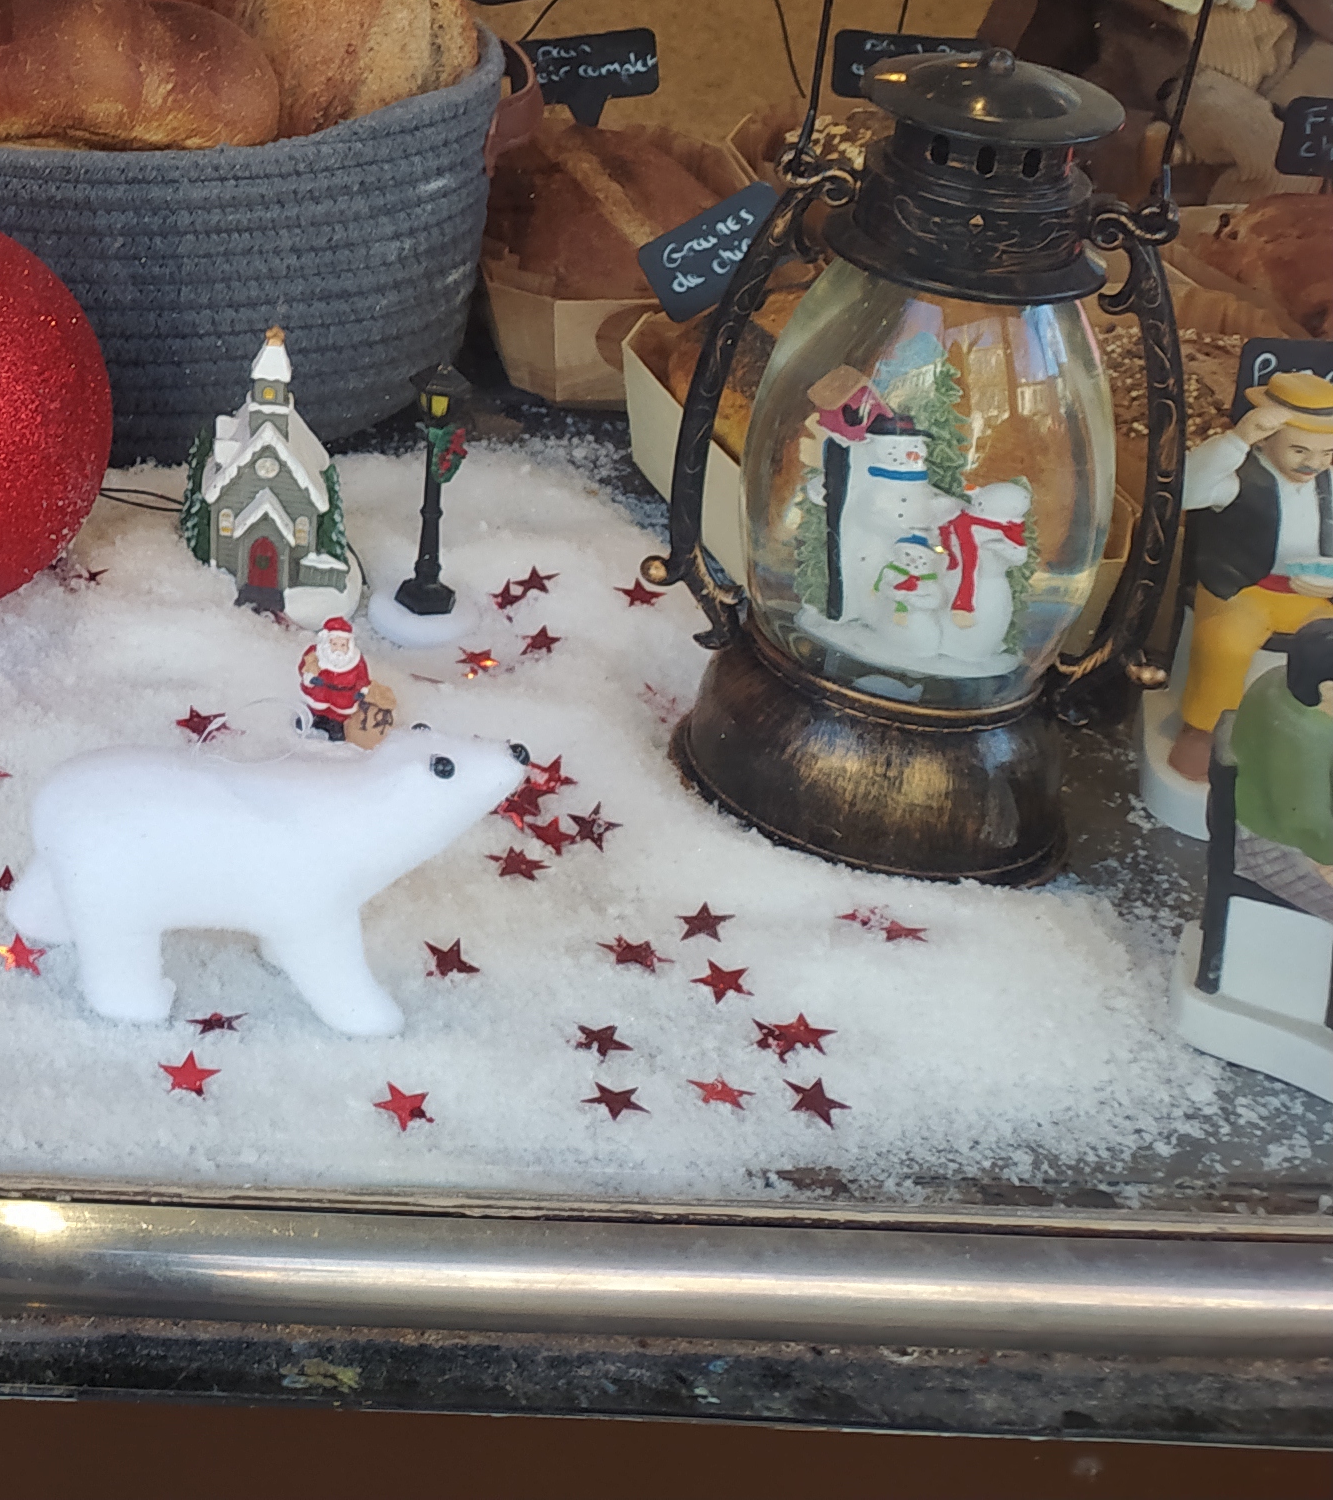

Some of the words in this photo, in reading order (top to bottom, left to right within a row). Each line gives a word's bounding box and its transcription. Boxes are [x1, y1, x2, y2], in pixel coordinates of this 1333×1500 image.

[535, 64, 571, 84] oir
[662, 208, 755, 269] Graines
[671, 271, 706, 293] de
